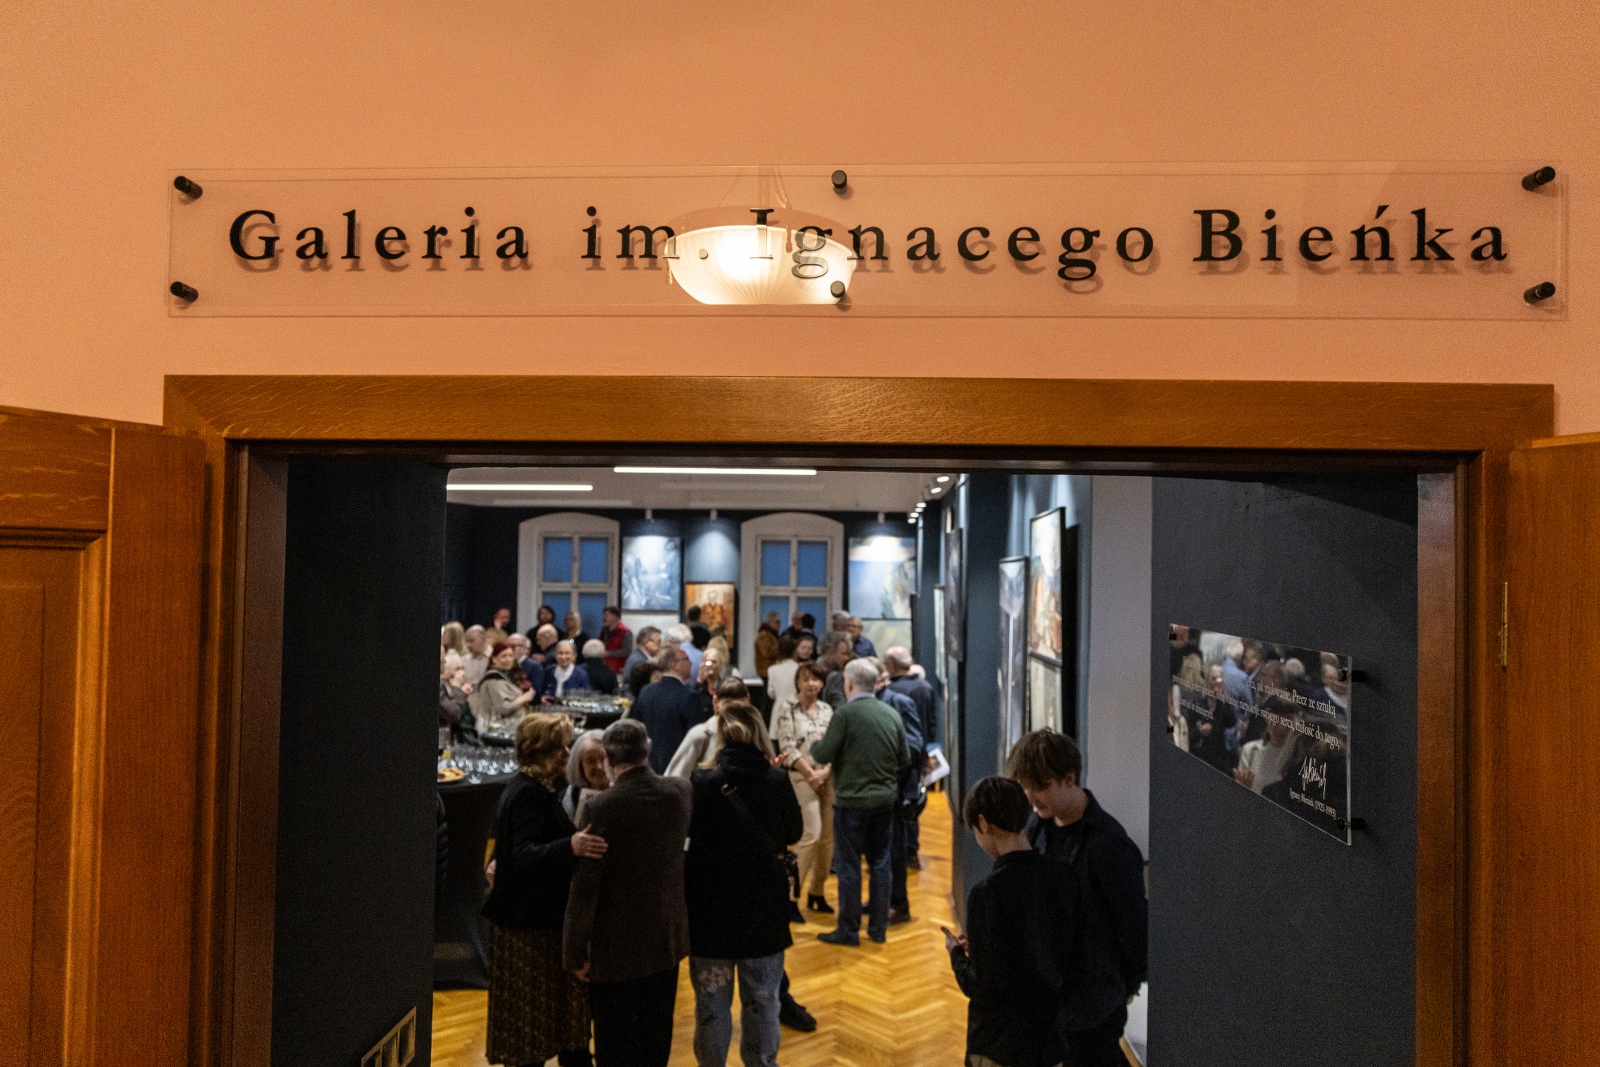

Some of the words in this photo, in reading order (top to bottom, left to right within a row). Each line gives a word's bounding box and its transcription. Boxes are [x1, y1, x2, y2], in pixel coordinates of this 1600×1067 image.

[229, 206, 529, 260] Galeria
[580, 205, 708, 260] im.
[749, 207, 1155, 281] Ignacego
[1192, 204, 1508, 263] Bieńka
[1292, 689, 1308, 707] Precz
[1308, 698, 1316, 709] ze
[1316, 698, 1337, 719] sztuką
[1295, 718, 1315, 738] miłość
[1315, 725, 1324, 742] do
[1324, 732, 1341, 751] tego,
